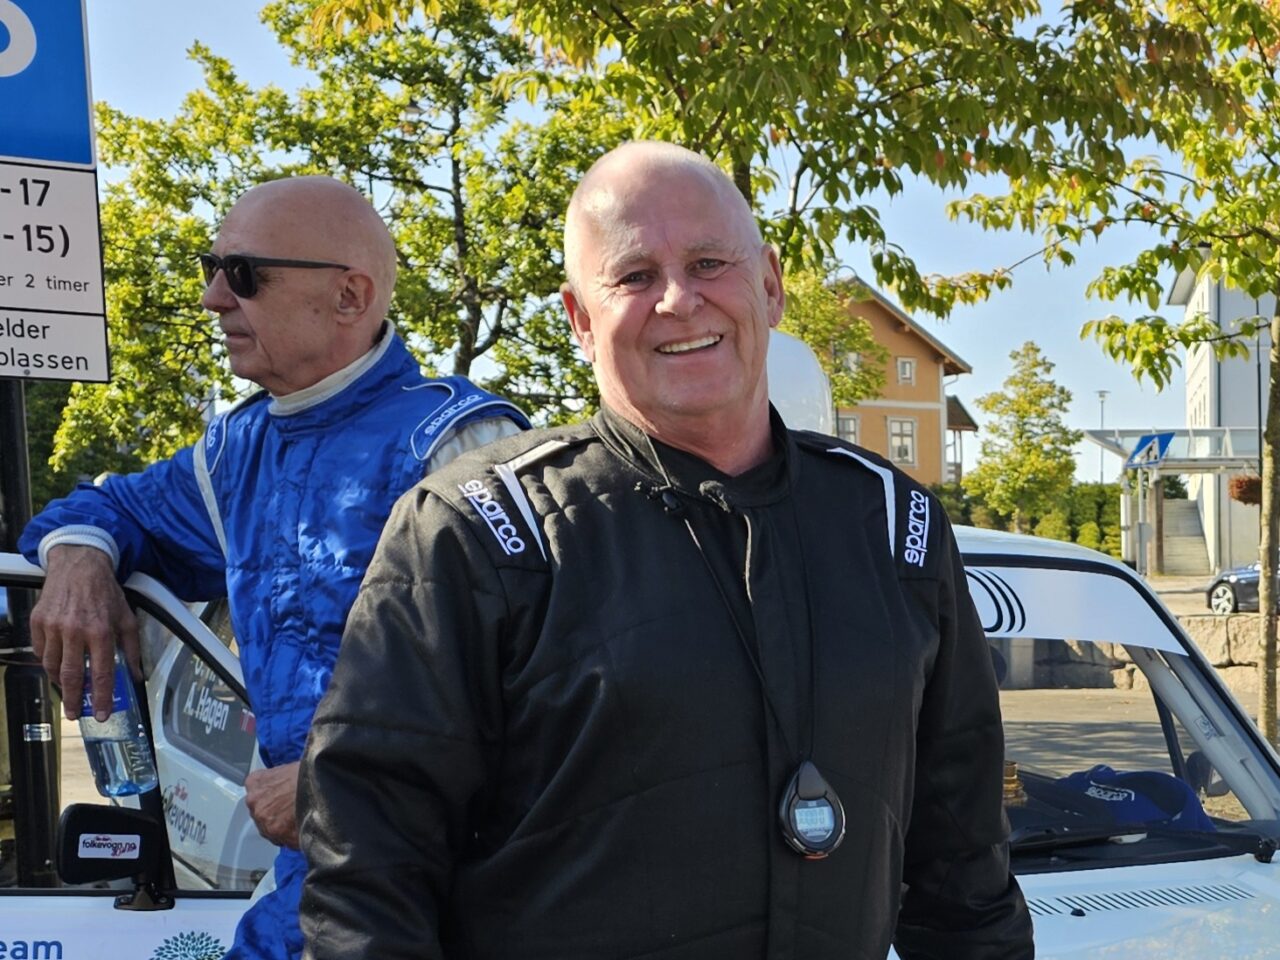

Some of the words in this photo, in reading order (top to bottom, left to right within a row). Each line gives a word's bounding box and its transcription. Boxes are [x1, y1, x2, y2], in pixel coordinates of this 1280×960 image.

[25, 274, 35, 288] 2
[46, 275, 90, 292] timer
[458, 480, 526, 555] sparco
[904, 489, 929, 566] sparco
[195, 686, 229, 735] Hagen
